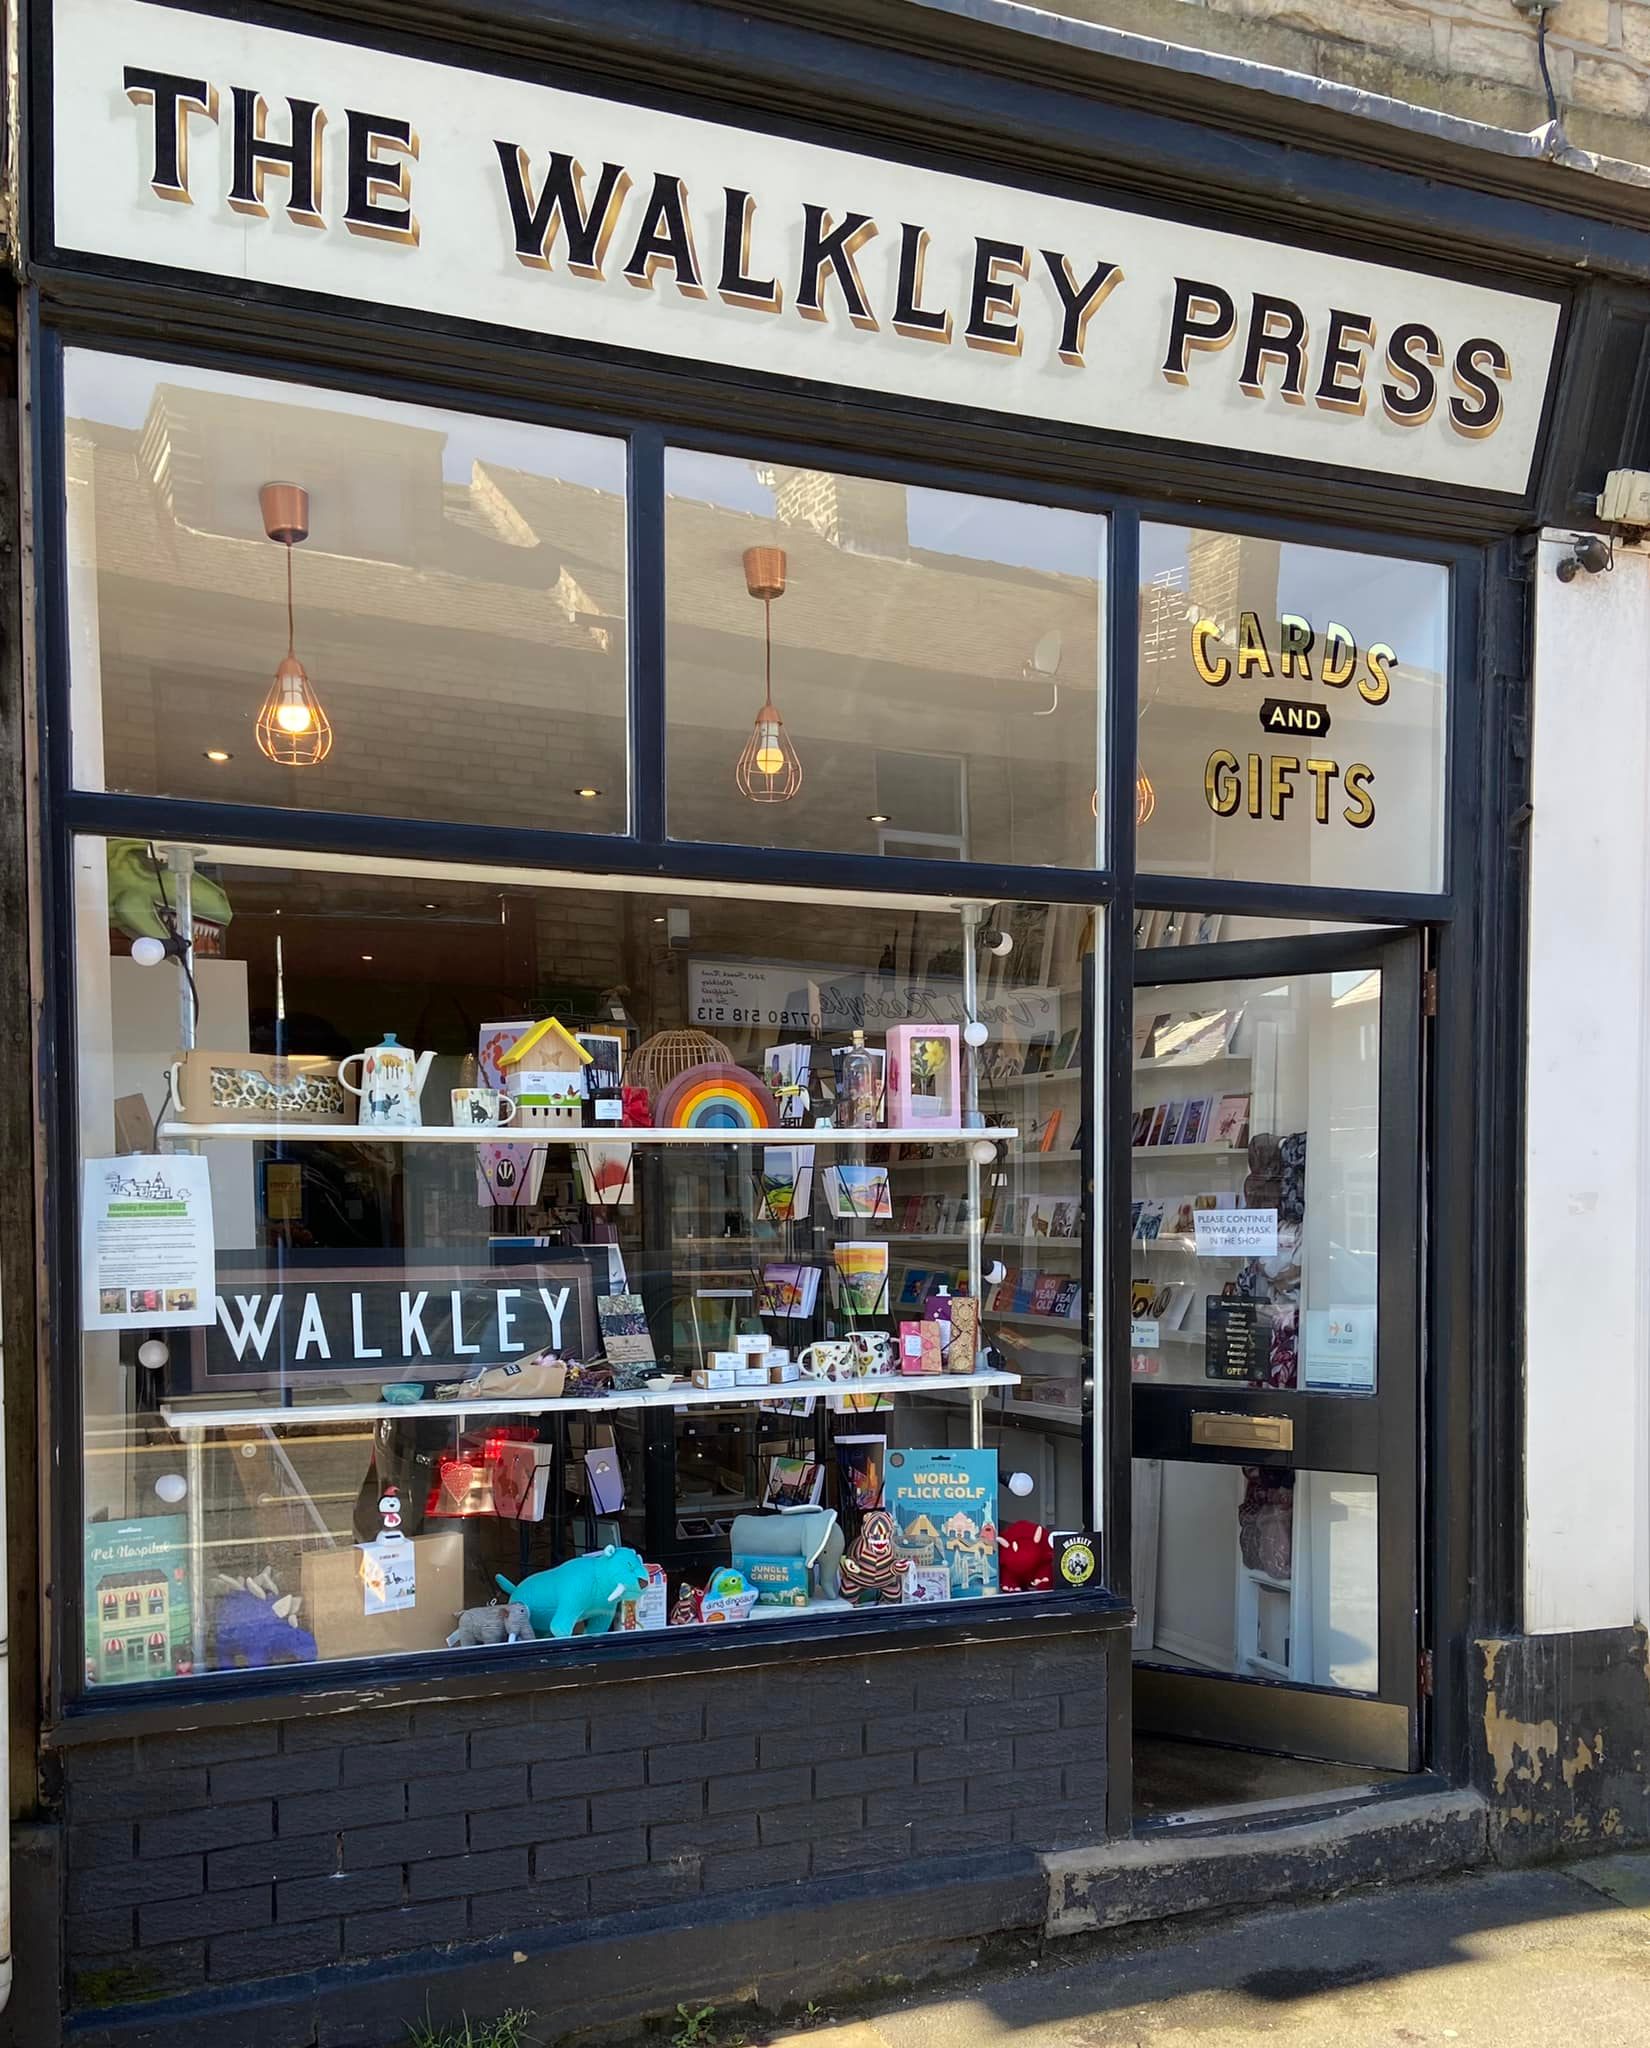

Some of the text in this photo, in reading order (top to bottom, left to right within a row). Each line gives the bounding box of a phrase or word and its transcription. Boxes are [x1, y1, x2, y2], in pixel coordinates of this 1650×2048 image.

[122, 64, 1512, 440] THE WALKLEY PRESS
[1191, 611, 1399, 706] CARDS
[1269, 706, 1322, 731] AND
[1204, 749, 1376, 829] GIFTS
[1198, 1214, 1273, 1224] PLEASE CONTINUE
[1201, 1226, 1271, 1234] TO WEAR A MASK
[1210, 1237, 1260, 1245] IN THE SHOP
[215, 1287, 570, 1362] WALKLEY
[913, 1472, 970, 1485] WORLD
[897, 1487, 986, 1499] FLICK GOLF
[1063, 1537, 1092, 1549] WALKLEY
[91, 1541, 170, 1560] Pet Hospital
[751, 1565, 789, 1574] JUNGLE
[751, 1573, 789, 1582] GARDEN
